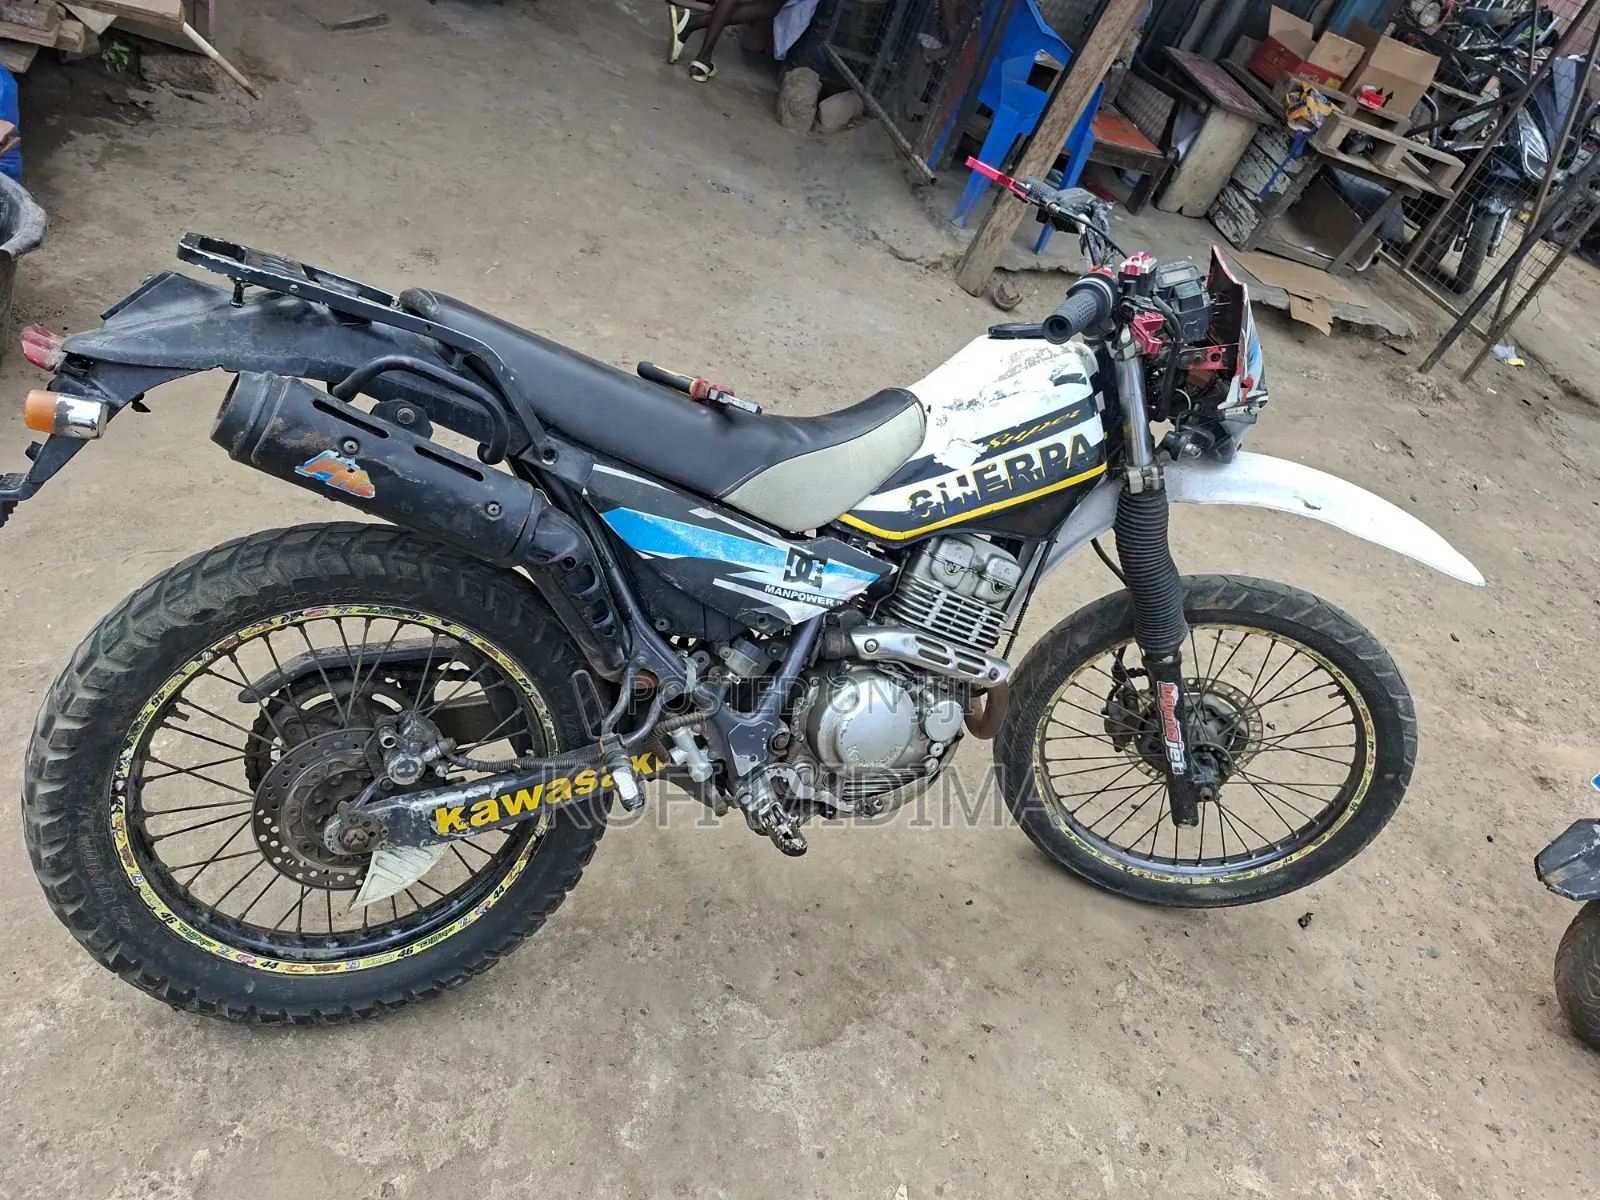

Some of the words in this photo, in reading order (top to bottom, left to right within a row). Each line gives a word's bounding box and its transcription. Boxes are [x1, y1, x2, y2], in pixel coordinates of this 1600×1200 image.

[906, 432, 1094, 522] SHERPA
[764, 584, 835, 607] MANPOWER
[260, 960, 279, 970] 44
